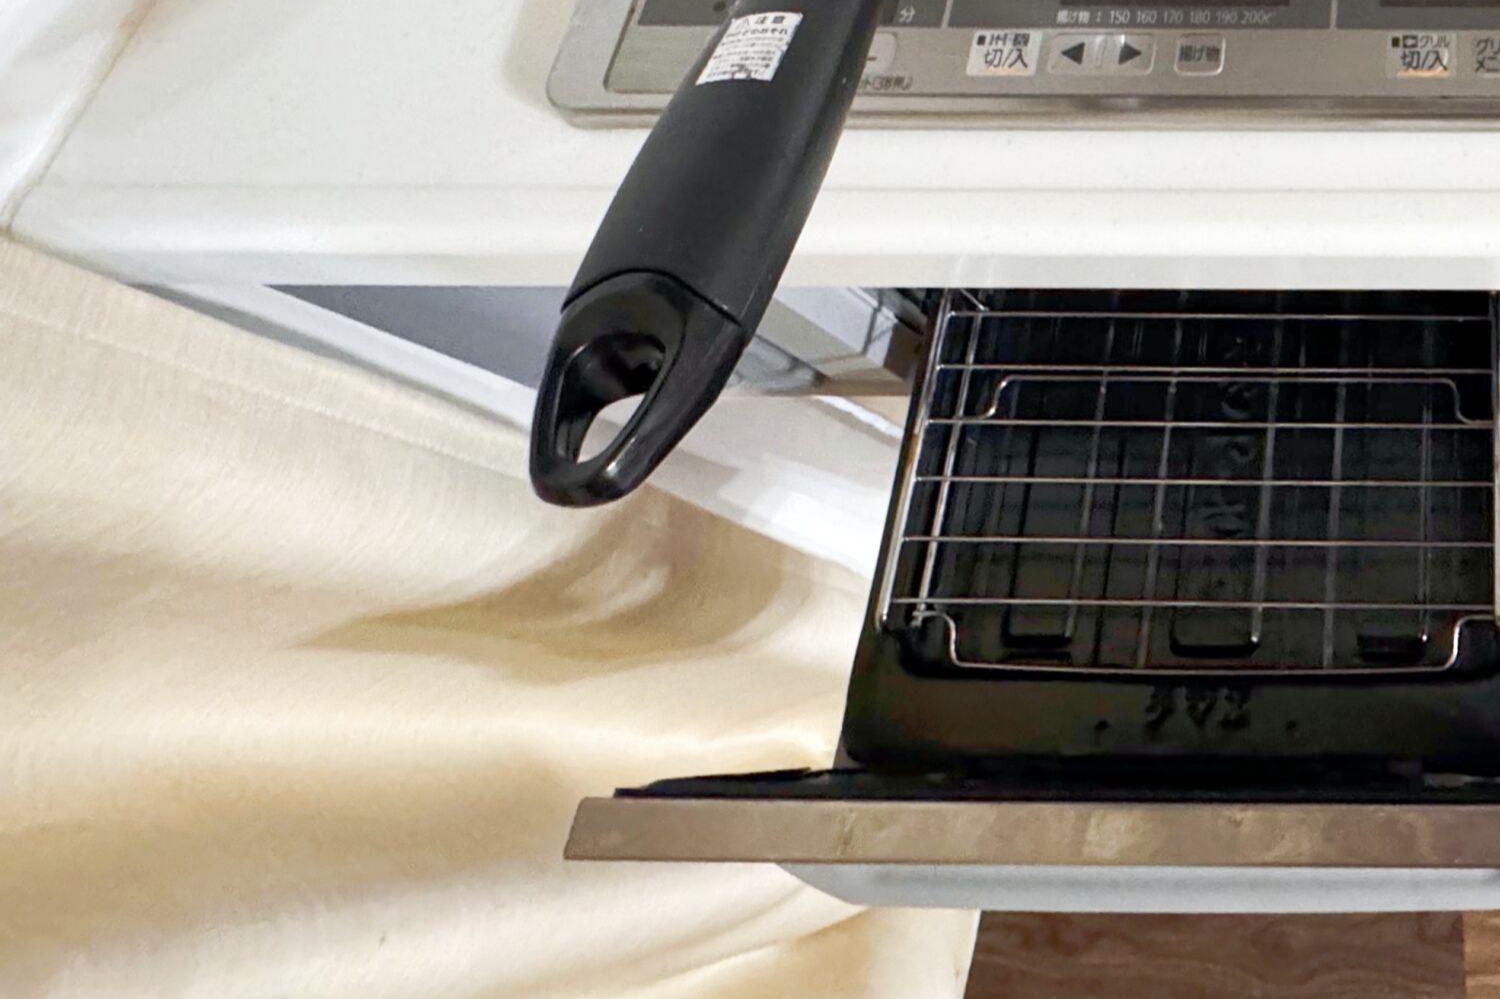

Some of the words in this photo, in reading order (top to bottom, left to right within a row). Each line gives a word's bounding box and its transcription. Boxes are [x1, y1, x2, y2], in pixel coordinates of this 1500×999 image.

[1109, 9, 1130, 25] 150
[1136, 9, 1157, 25] 160
[1163, 9, 1183, 25] 170
[1189, 9, 1210, 25] 180
[1215, 9, 1237, 25] 190
[1401, 50, 1448, 71] 切/入
